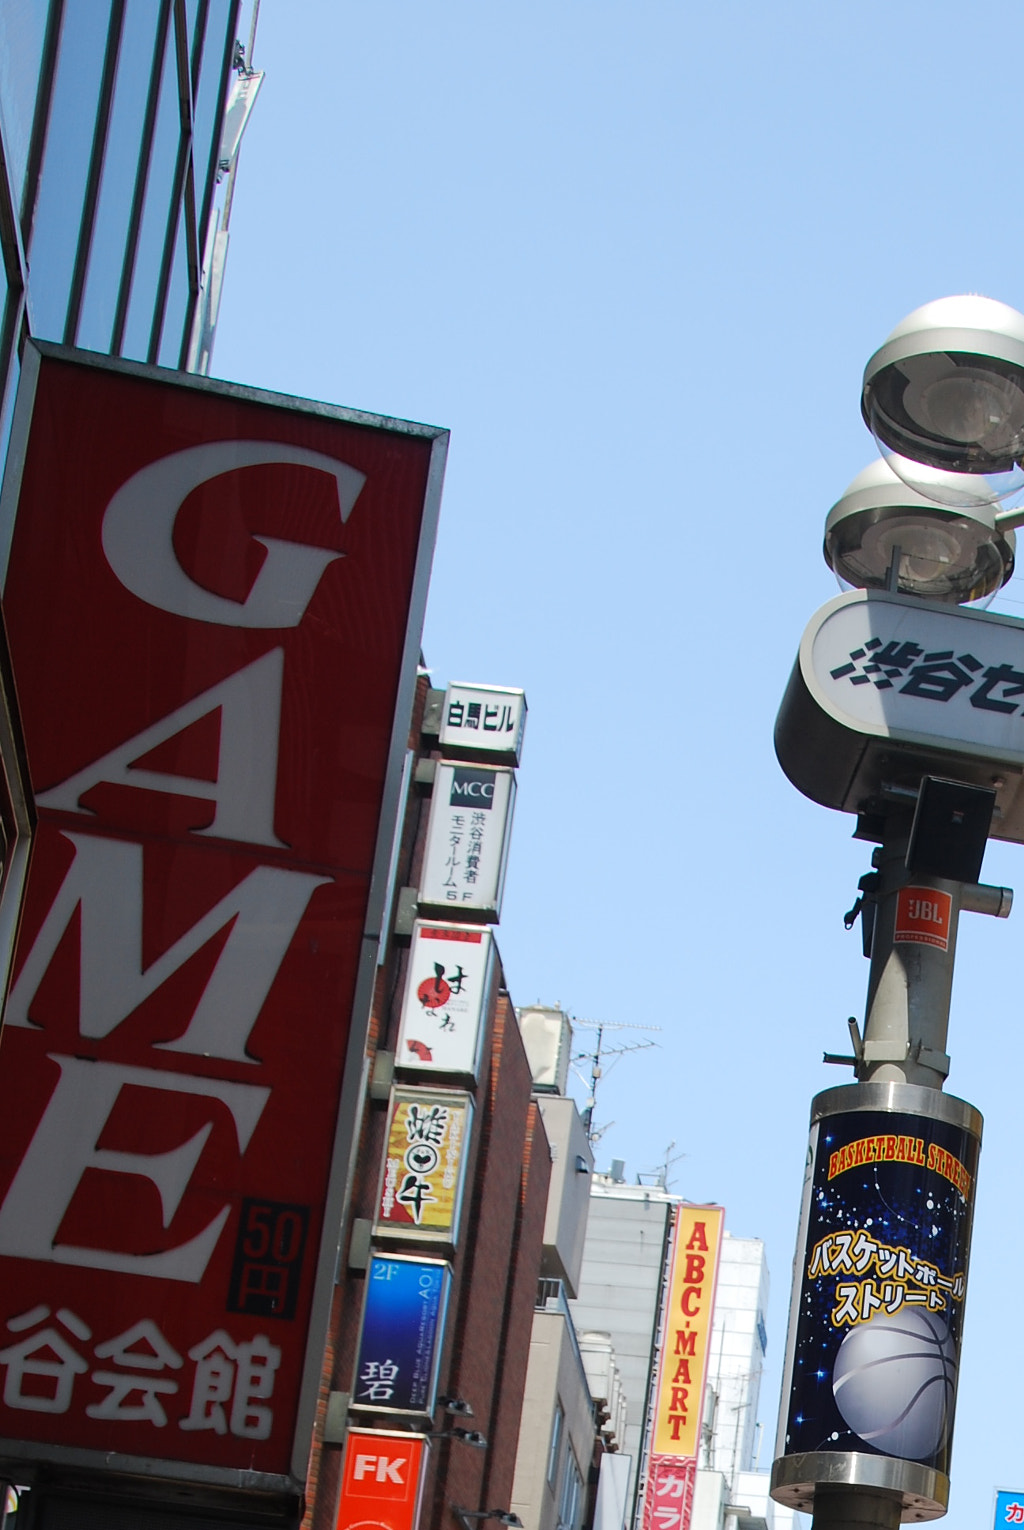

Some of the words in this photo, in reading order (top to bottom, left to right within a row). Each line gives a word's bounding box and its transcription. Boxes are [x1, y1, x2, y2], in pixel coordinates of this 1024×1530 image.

[447, 701, 514, 733] 白馬ビル
[451, 781, 496, 798] MCC
[0, 440, 367, 1283] GAME
[442, 815, 466, 888] モニタールーム
[908, 900, 943, 924] JBL
[828, 1134, 926, 1180] BASKETBALL
[374, 1264, 399, 1281] 2F
[418, 1268, 434, 1300] AOI
[810, 1232, 965, 1300] バスケットボール
[832, 1280, 947, 1327] ストリート
[667, 1222, 708, 1441] ABC-MART
[357, 1358, 400, 1401] 碧
[353, 1454, 407, 1485] FK
